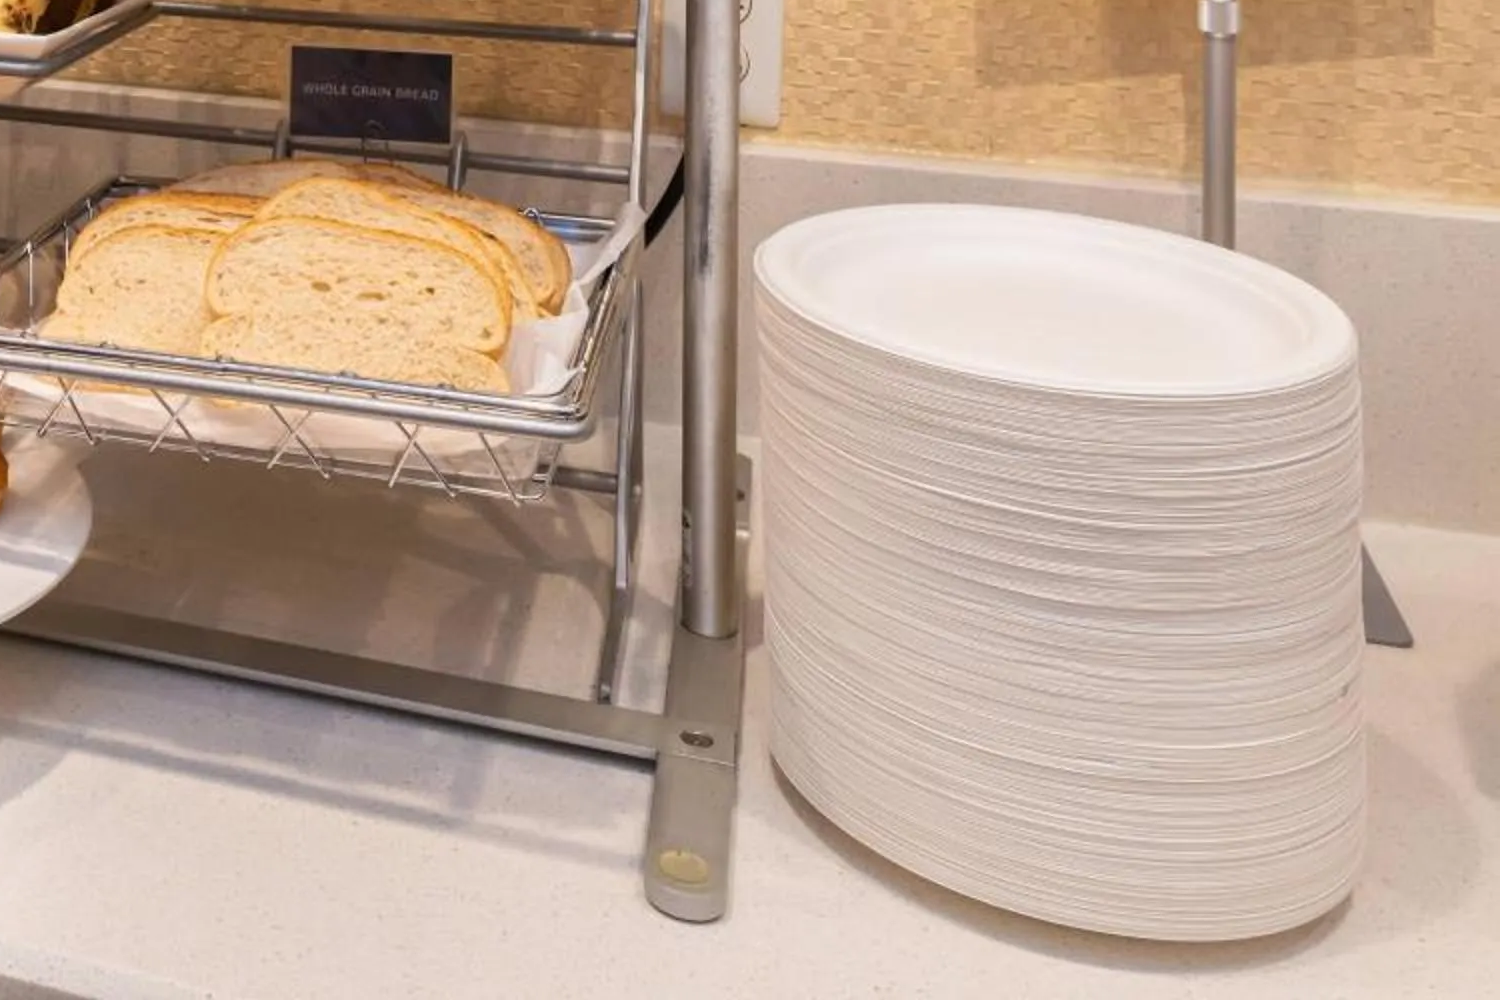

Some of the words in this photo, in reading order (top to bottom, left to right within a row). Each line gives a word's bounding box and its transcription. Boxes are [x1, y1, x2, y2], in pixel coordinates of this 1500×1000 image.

[303, 82, 347, 96] WHOLE
[352, 84, 391, 98] GRAIN
[395, 87, 439, 101] BREAD
